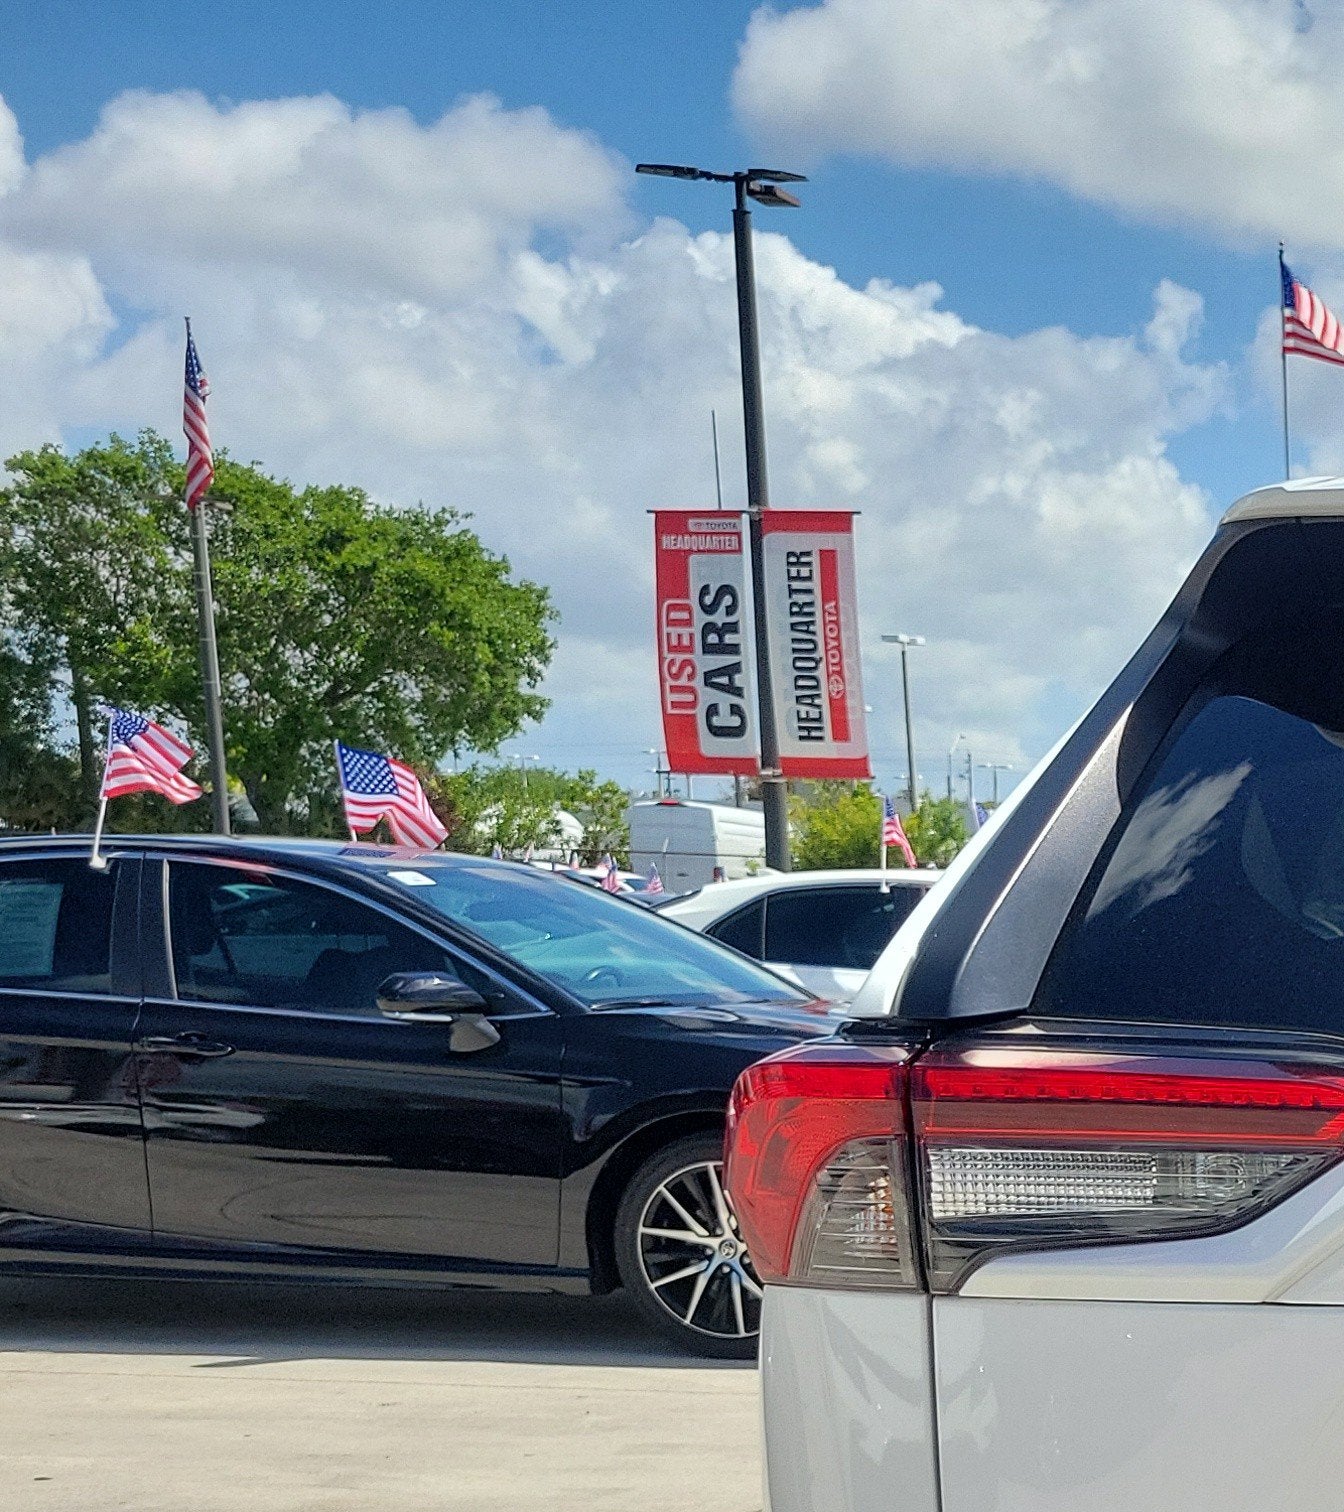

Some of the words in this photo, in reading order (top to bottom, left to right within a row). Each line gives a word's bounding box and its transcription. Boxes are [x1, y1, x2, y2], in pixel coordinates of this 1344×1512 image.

[662, 534, 739, 551] HEADQUARTER
[706, 521, 738, 530] TOYOTA
[664, 601, 699, 714] USED
[699, 583, 747, 738] CARS
[786, 549, 825, 741] HEADQUARTER
[824, 601, 843, 672] TOYOTA
